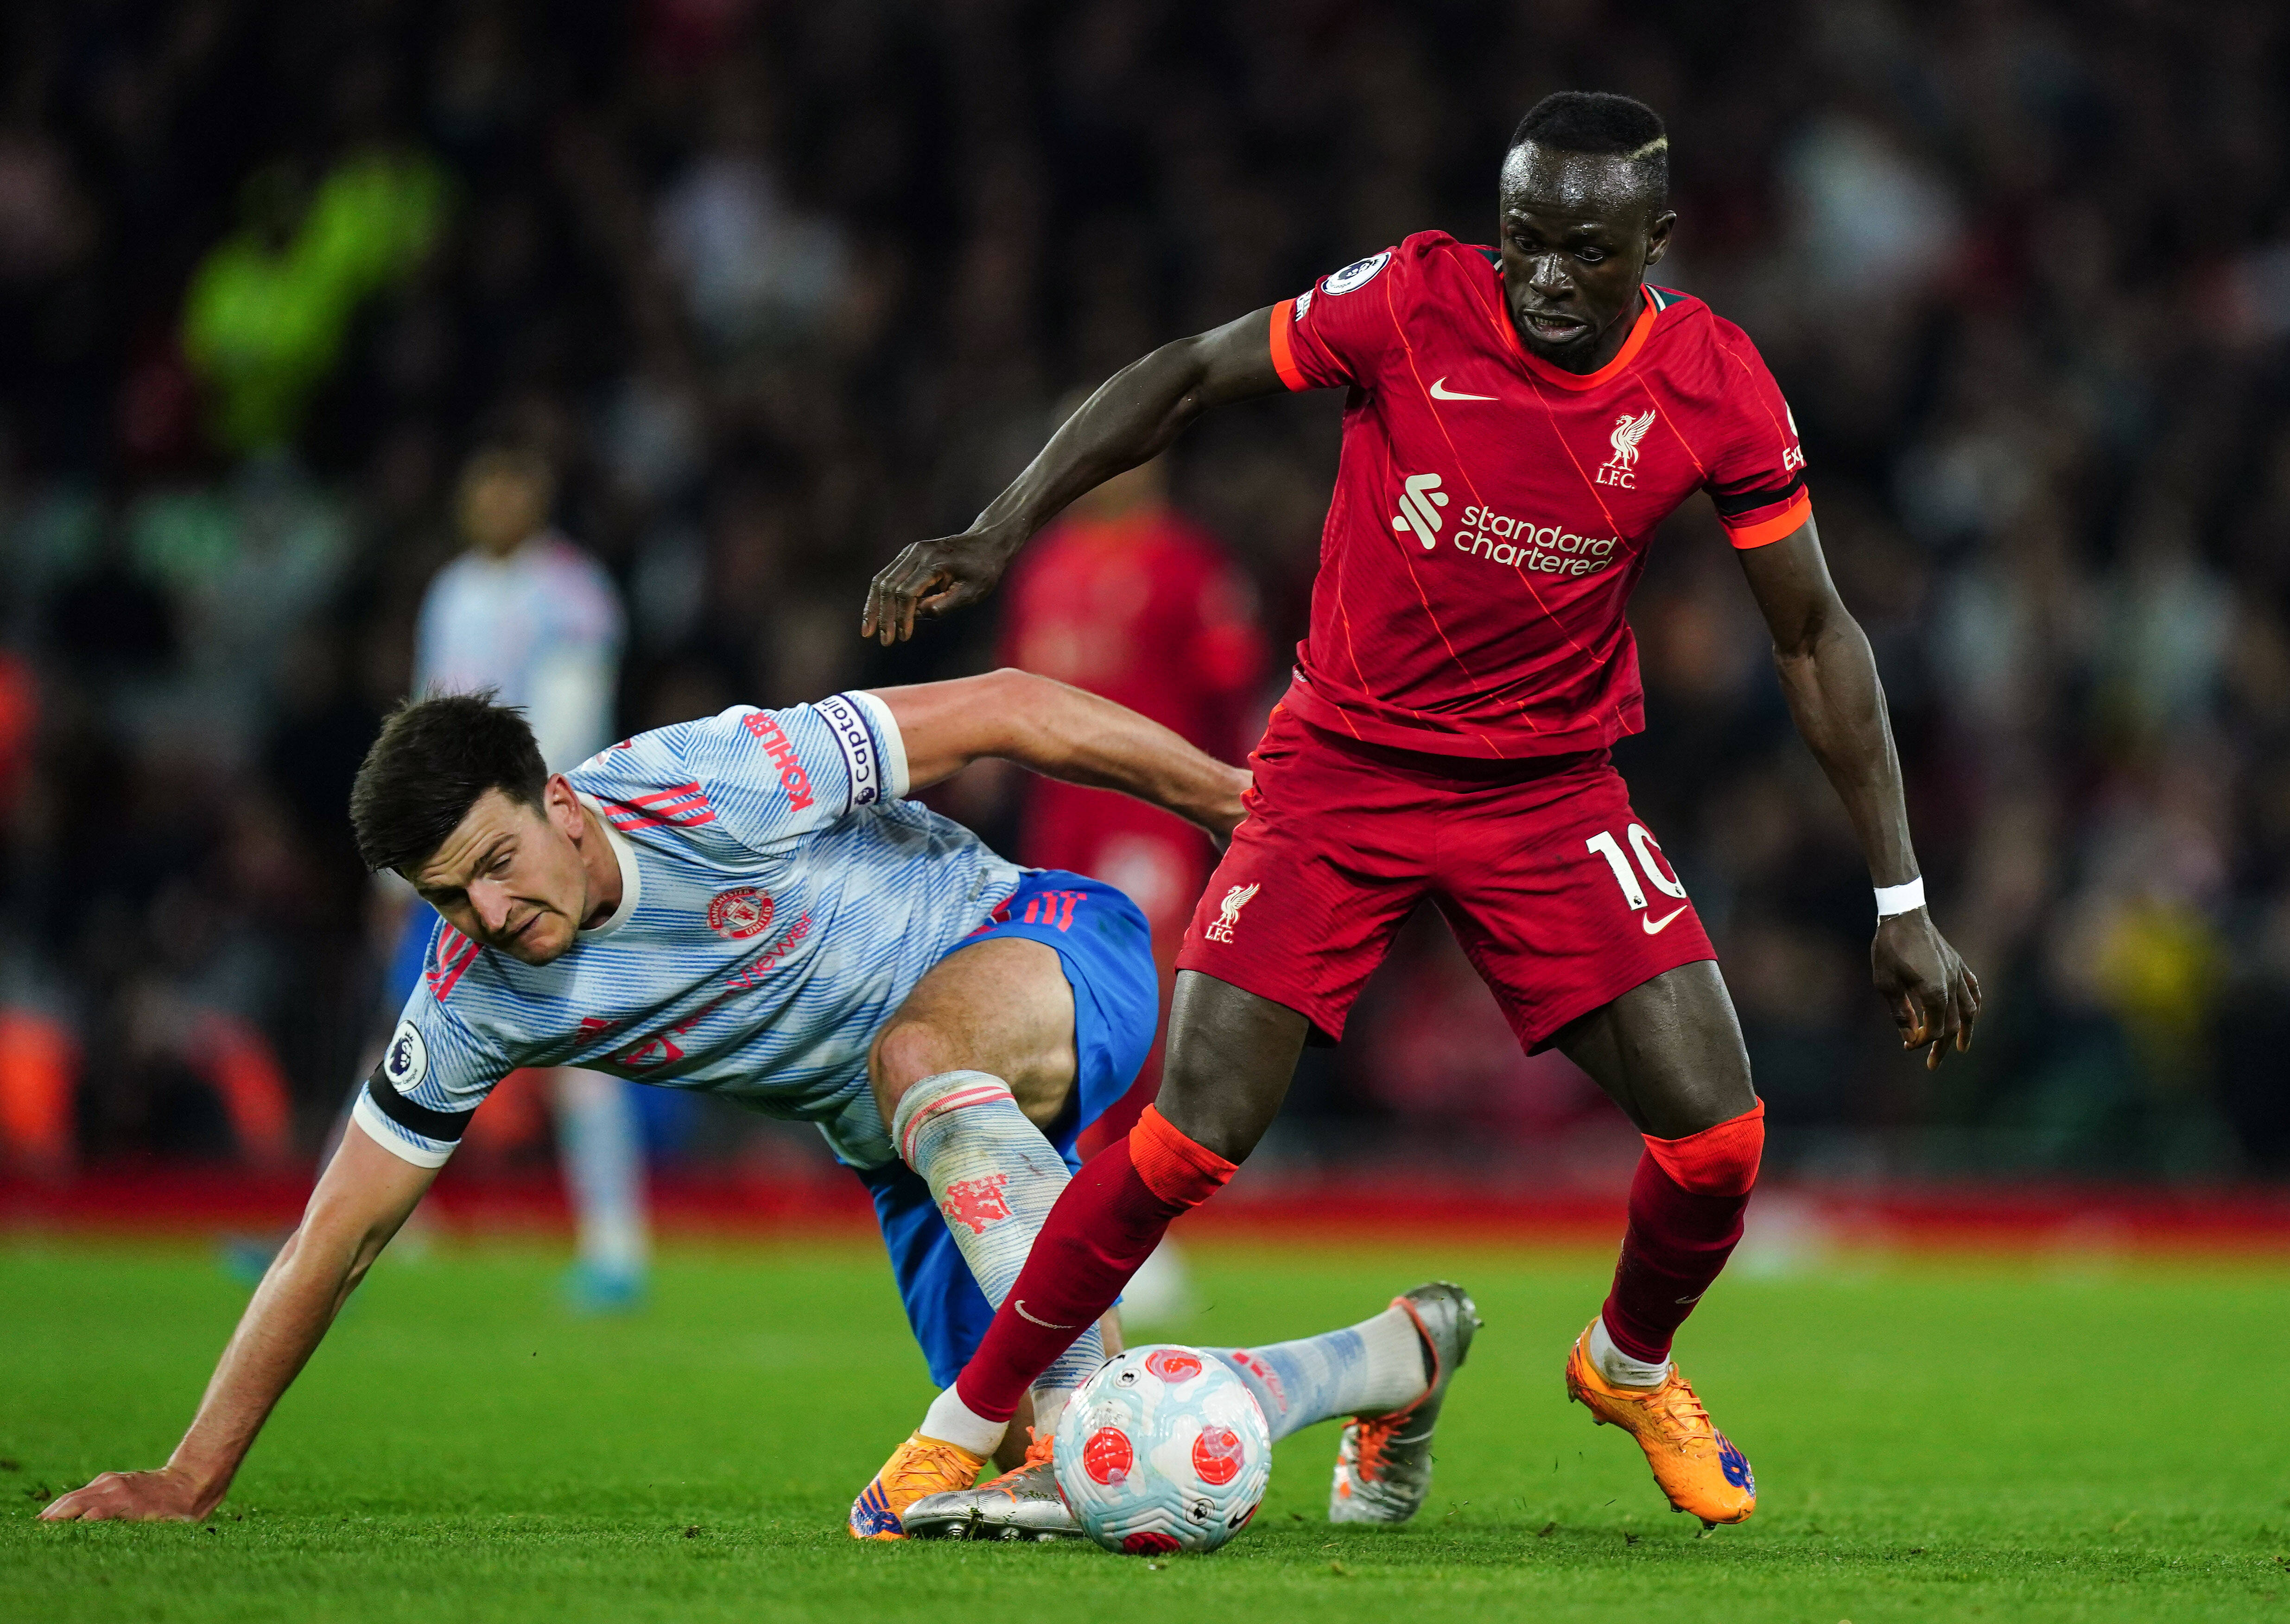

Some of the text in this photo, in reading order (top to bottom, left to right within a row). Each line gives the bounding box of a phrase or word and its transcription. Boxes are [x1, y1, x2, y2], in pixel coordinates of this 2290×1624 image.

[1595, 468, 1636, 489] L.F.C.
[1454, 531, 1613, 576] chartered
[1461, 506, 1618, 556] standard
[743, 712, 814, 812] KOHLER
[822, 698, 869, 782] captain
[1585, 823, 1687, 911] 10
[710, 888, 750, 926] MANCHESTER
[745, 906, 772, 935] UNITED
[1205, 926, 1233, 944] L.F.C.
